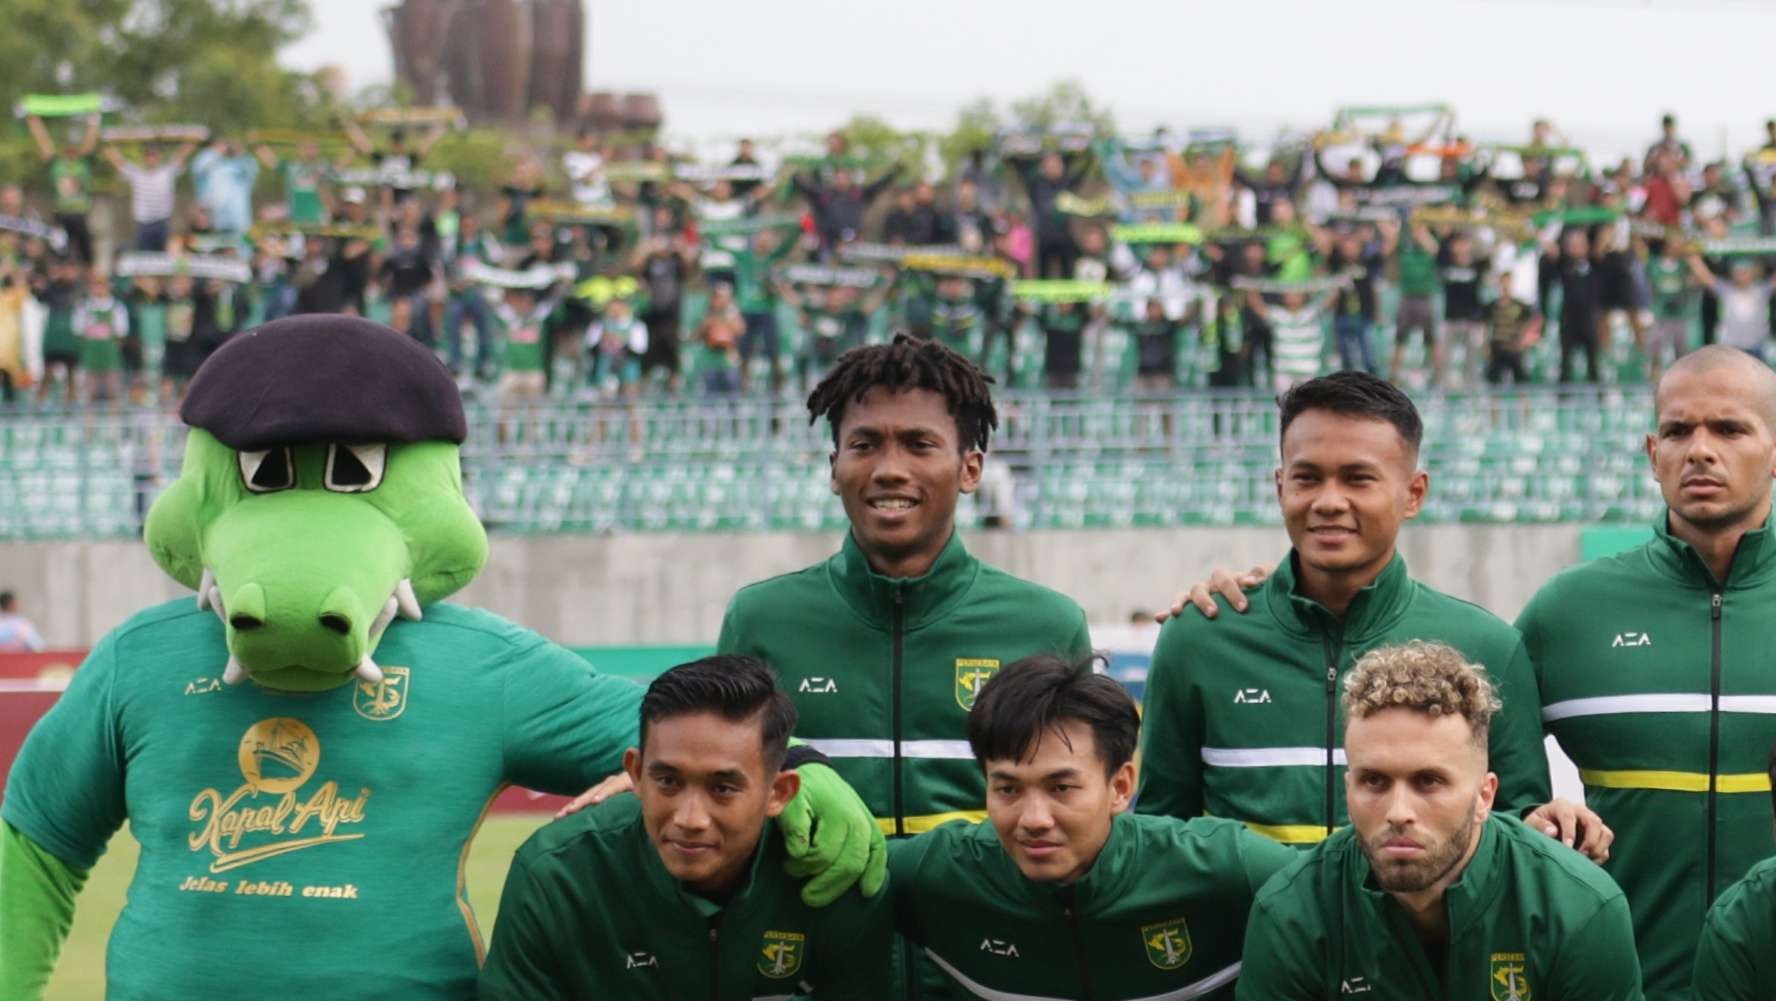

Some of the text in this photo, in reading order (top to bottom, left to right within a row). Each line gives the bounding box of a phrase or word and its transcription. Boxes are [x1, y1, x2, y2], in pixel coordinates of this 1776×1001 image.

[189, 781, 371, 858] Kapal Api
[180, 876, 359, 899] Jelas lebih enak
